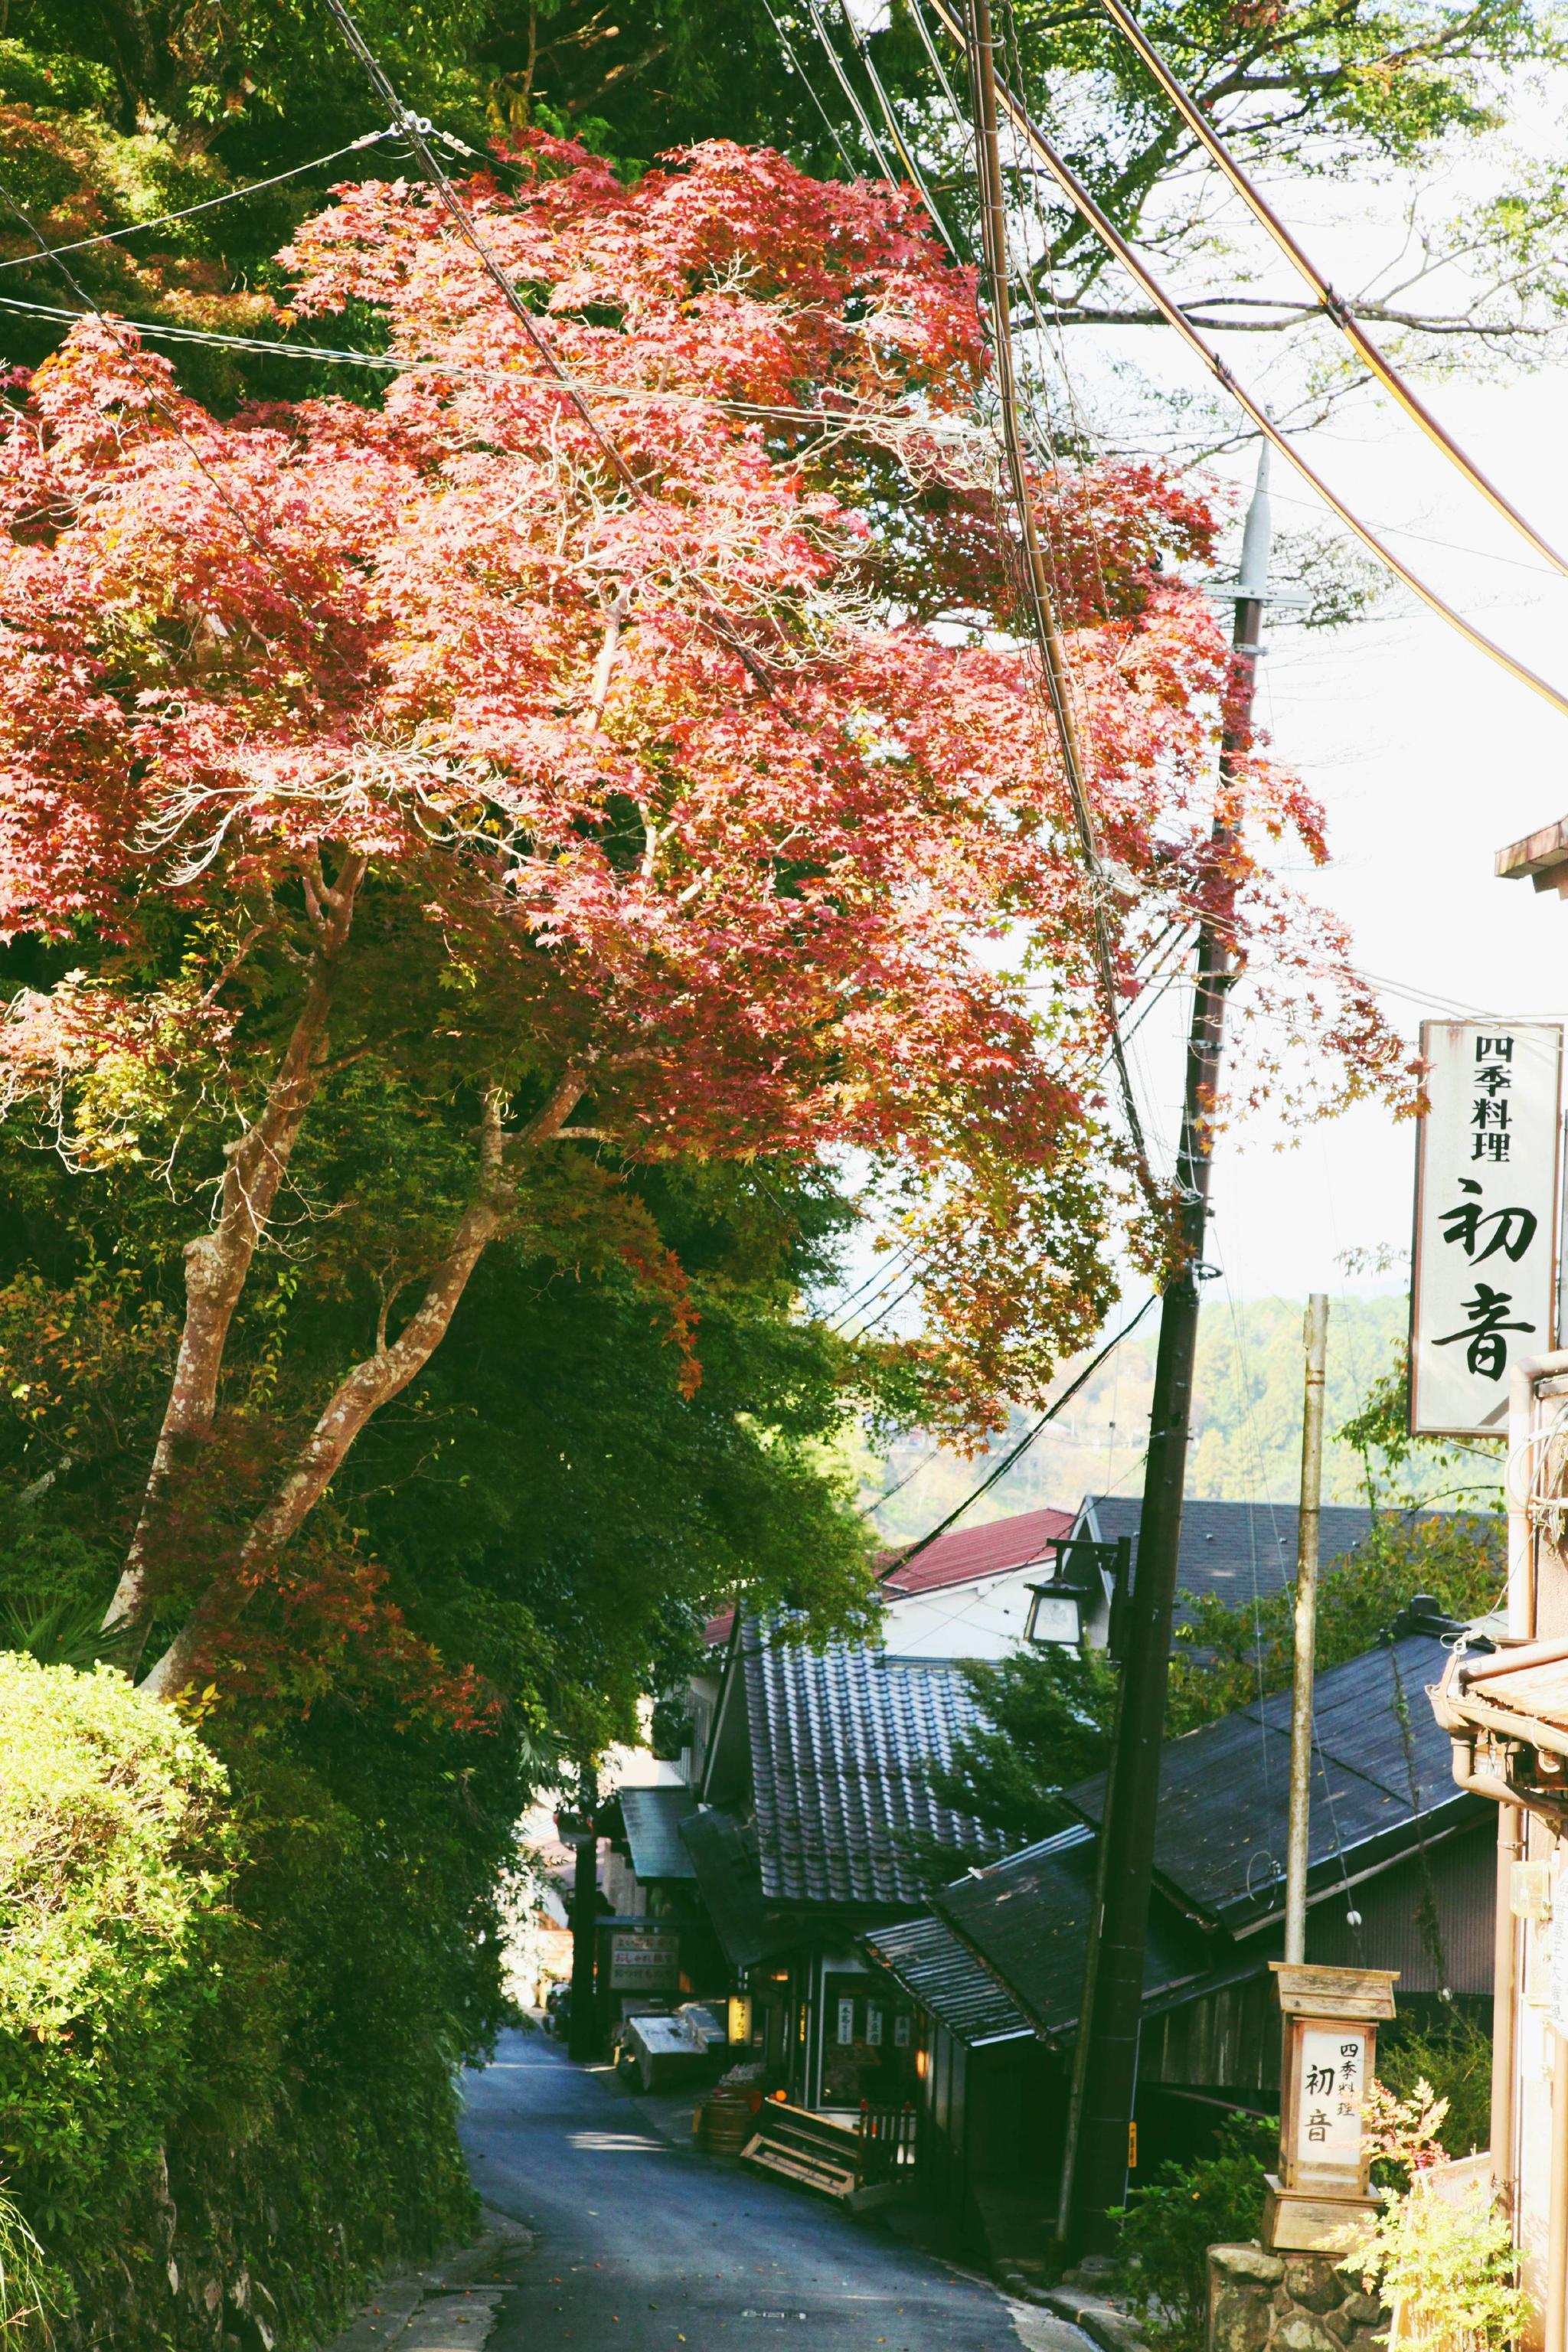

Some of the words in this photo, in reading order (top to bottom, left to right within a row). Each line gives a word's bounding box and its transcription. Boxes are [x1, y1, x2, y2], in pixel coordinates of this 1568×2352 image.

[1470, 1035, 1515, 1163] 四季料理
[1431, 1178, 1538, 1382] 初音
[1304, 2064, 1334, 2142] 初音
[1337, 2043, 1359, 2117] 四季料理
